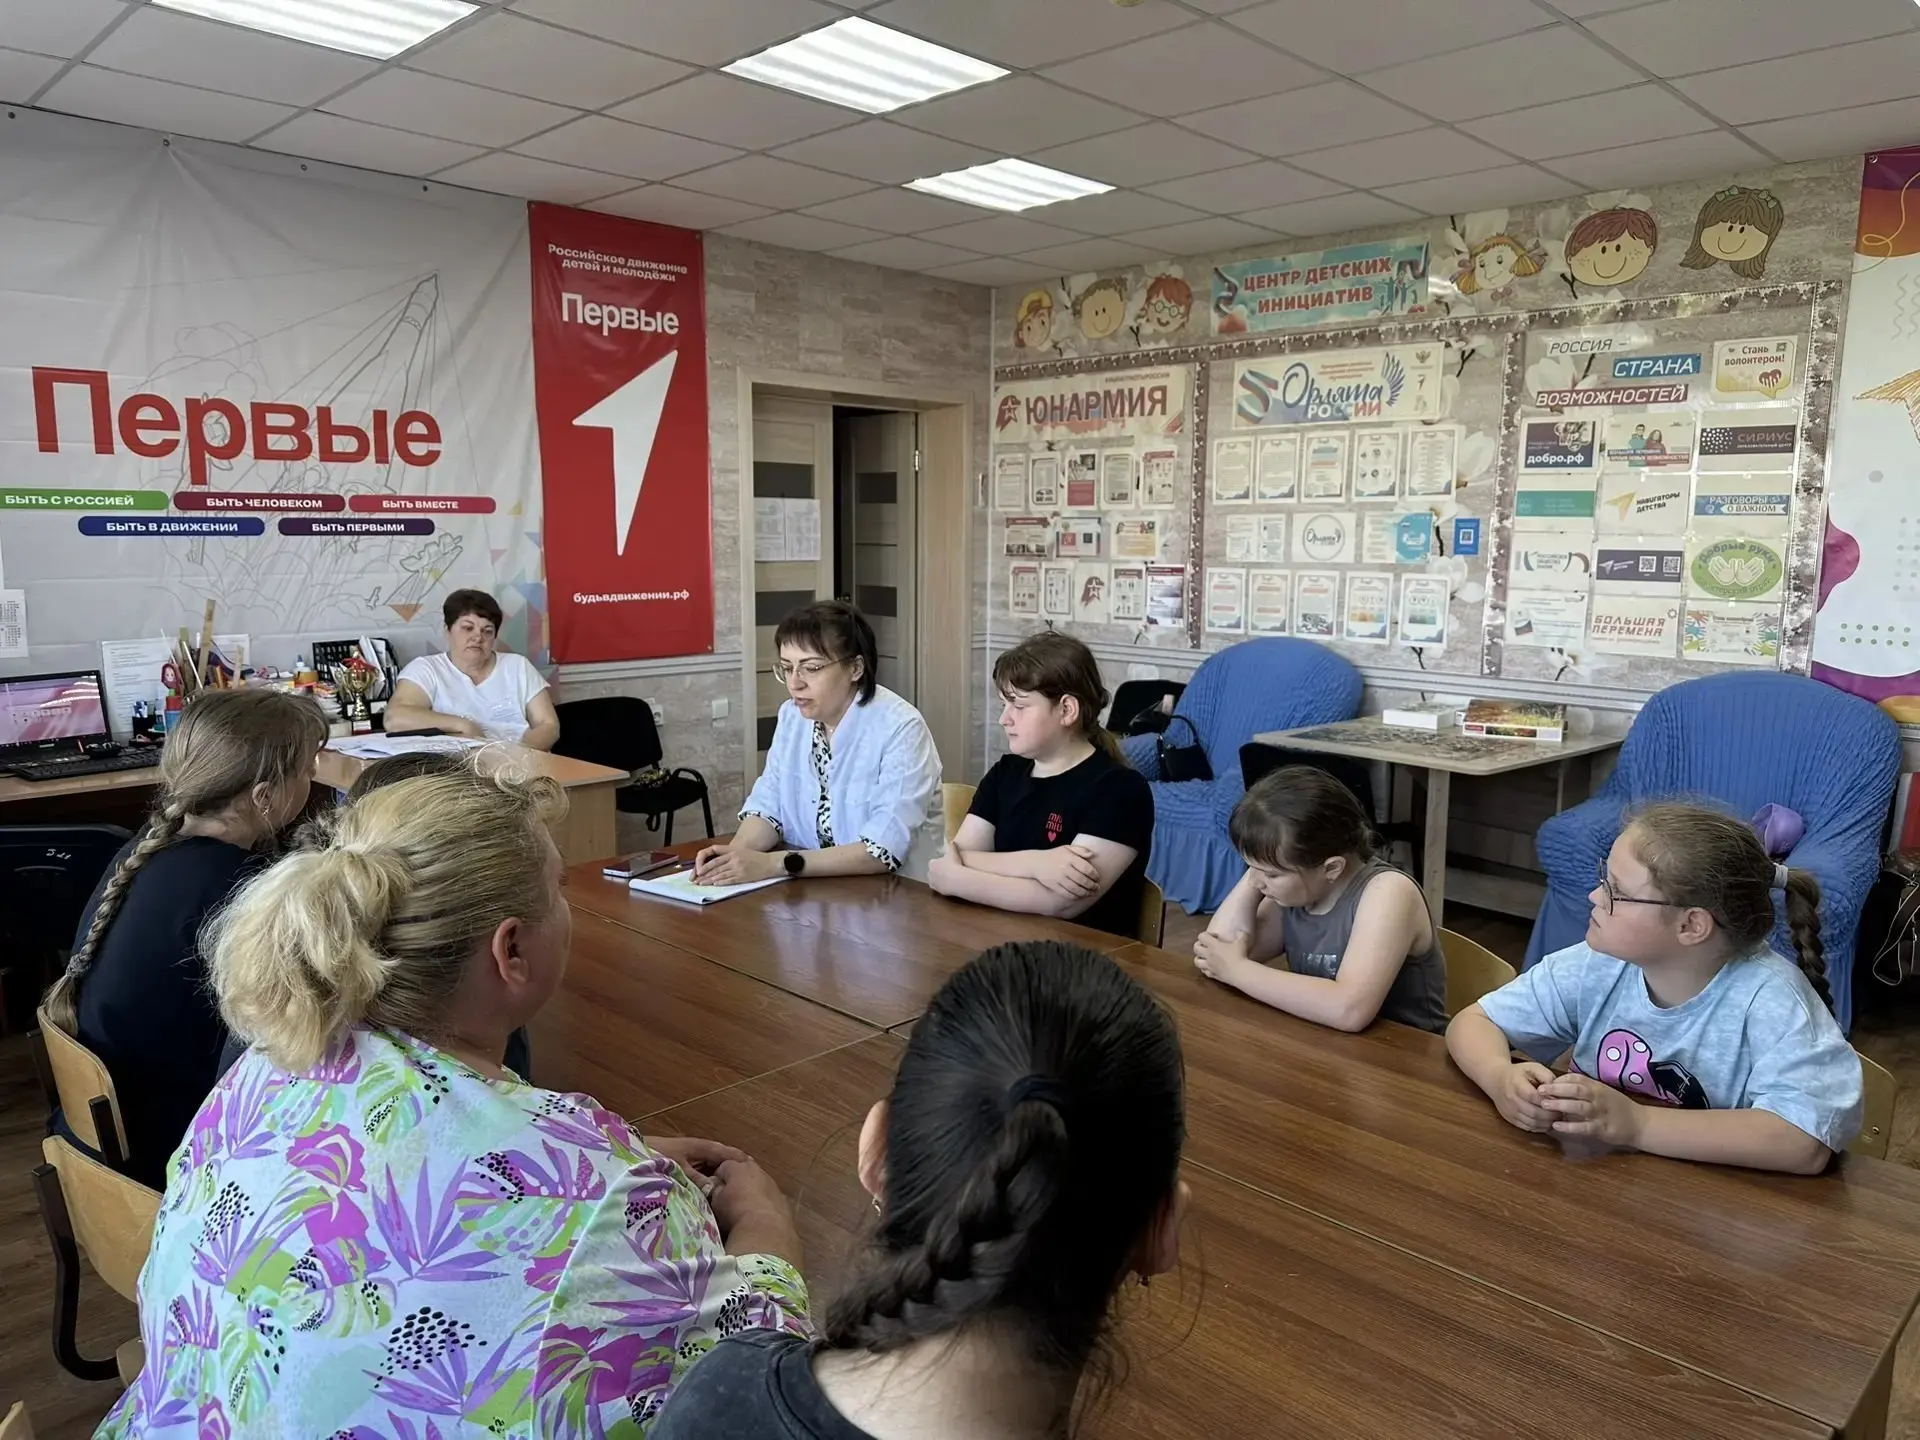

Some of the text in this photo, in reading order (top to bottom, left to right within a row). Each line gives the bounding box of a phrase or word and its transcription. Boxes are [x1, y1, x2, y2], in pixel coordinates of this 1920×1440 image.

[548, 244, 688, 275] Российское движение
[562, 258, 676, 282] детей и молодёжи
[1244, 256, 1392, 293] ЦЕНТР ДЕТСКИХ
[1257, 286, 1374, 314] ИНИЦИАТИВ
[561, 291, 680, 336] Первые
[1550, 338, 1613, 355] РОССИЯ
[1742, 345, 1769, 354] Стань
[1614, 357, 1693, 377] СТРАНА
[1282, 362, 1384, 419] Орлята
[1536, 384, 1687, 407] ВОЗМОЖНОСТЕЙ
[1025, 385, 1168, 425] ЮНАРМИЯ
[1307, 401, 1383, 420] РОССИИ
[32, 366, 442, 485] Первые
[1737, 431, 1793, 443] СИРИУС
[1527, 452, 1585, 465] добро.рф
[5, 495, 134, 506] БЫТЬ С РОССИЕЙ
[206, 498, 323, 508] БЫТЬ ЧЕЛОВЕКОМ
[382, 500, 459, 509] БЫТЬ ВМЕСТЕ
[1636, 491, 1681, 505] НАВИГАТОРЫ
[1709, 495, 1768, 504] РАЗГОВОРЫ
[1636, 501, 1667, 514] ДЕТСТВА
[106, 522, 238, 533] БЫТЬ В ДВИЖЕНИИ
[312, 523, 405, 532] БЫТЬ ПЕРВЫМИ
[1748, 544, 1775, 563] руки
[573, 589, 690, 604] будьвдвижении.рф
[1594, 615, 1667, 627] БОЛЬШАЯ
[1592, 625, 1664, 637] ПЕРЕМЕНА
[1045, 821, 1063, 832] miu
